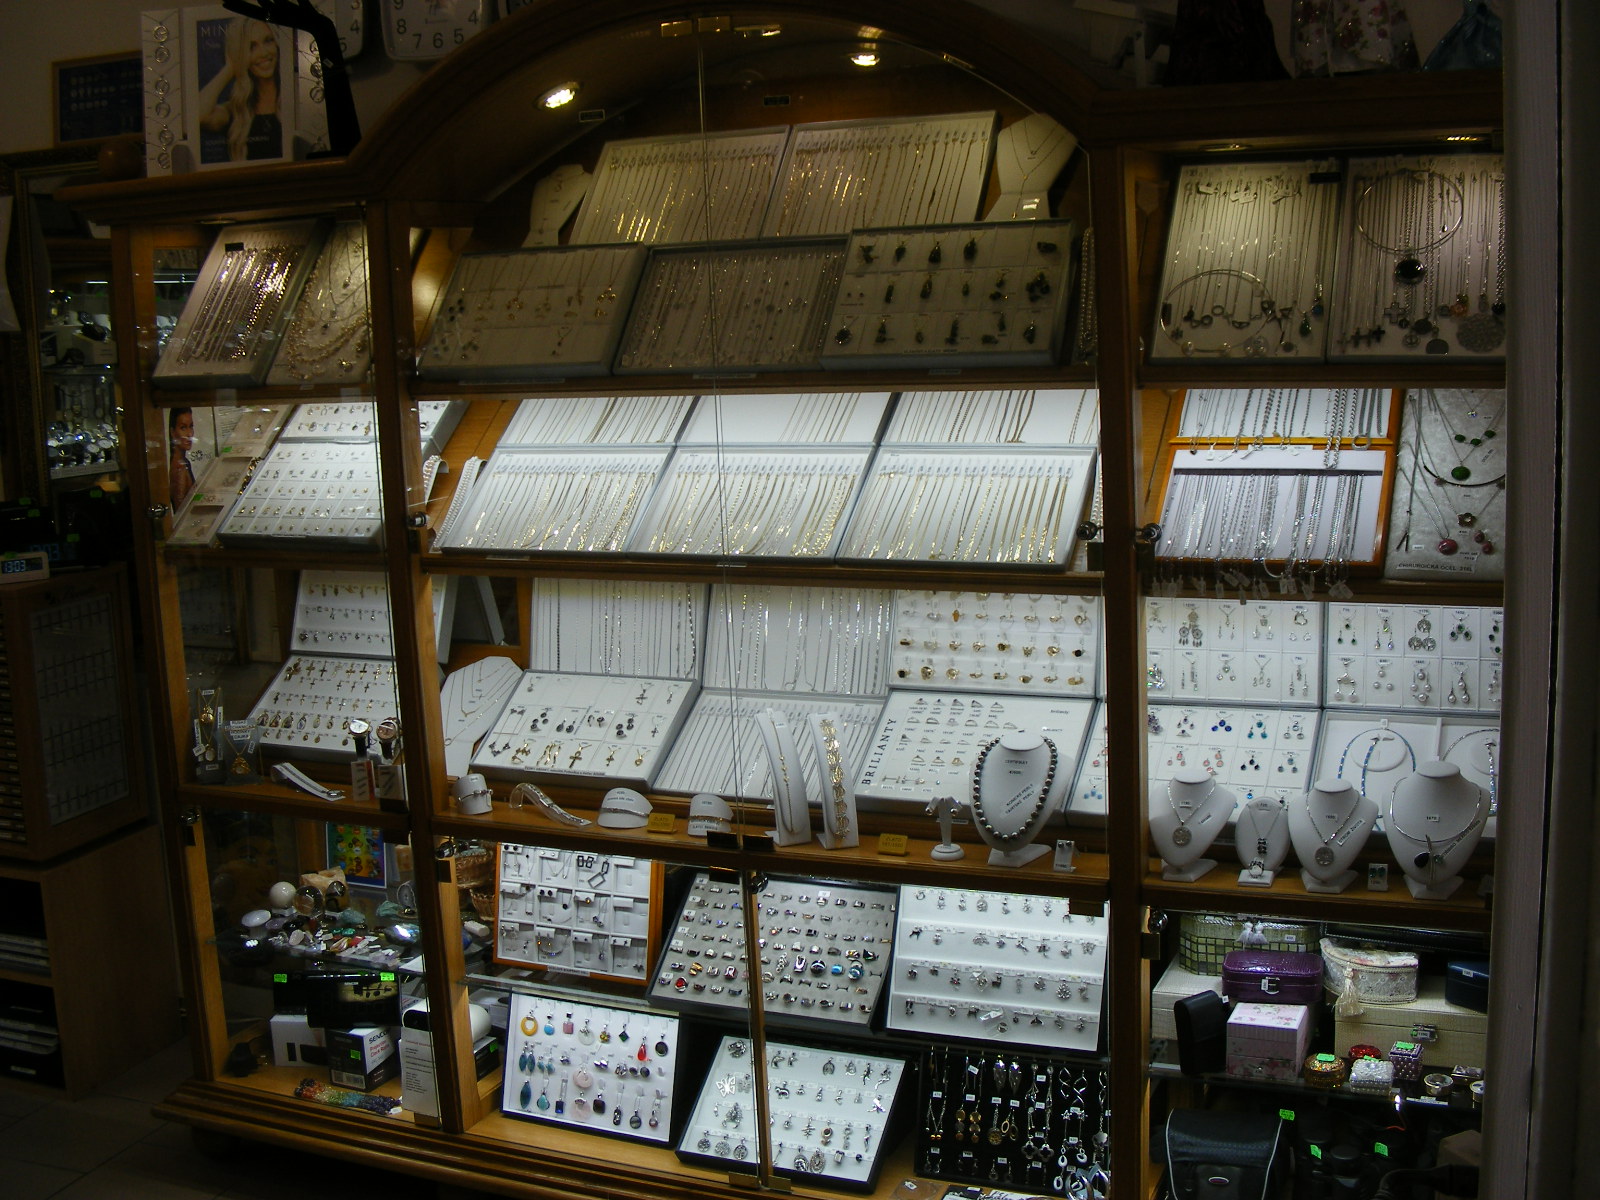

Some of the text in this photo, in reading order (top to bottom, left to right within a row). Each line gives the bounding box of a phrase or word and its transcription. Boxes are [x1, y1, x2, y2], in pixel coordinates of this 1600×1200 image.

[466, 9, 479, 25] 4
[350, 19, 360, 35] 4
[396, 18, 407, 35] 8
[412, 33, 422, 50] 7
[433, 32, 444, 49] 6
[453, 28, 465, 45] 5
[861, 718, 897, 787] BRILIANTY
